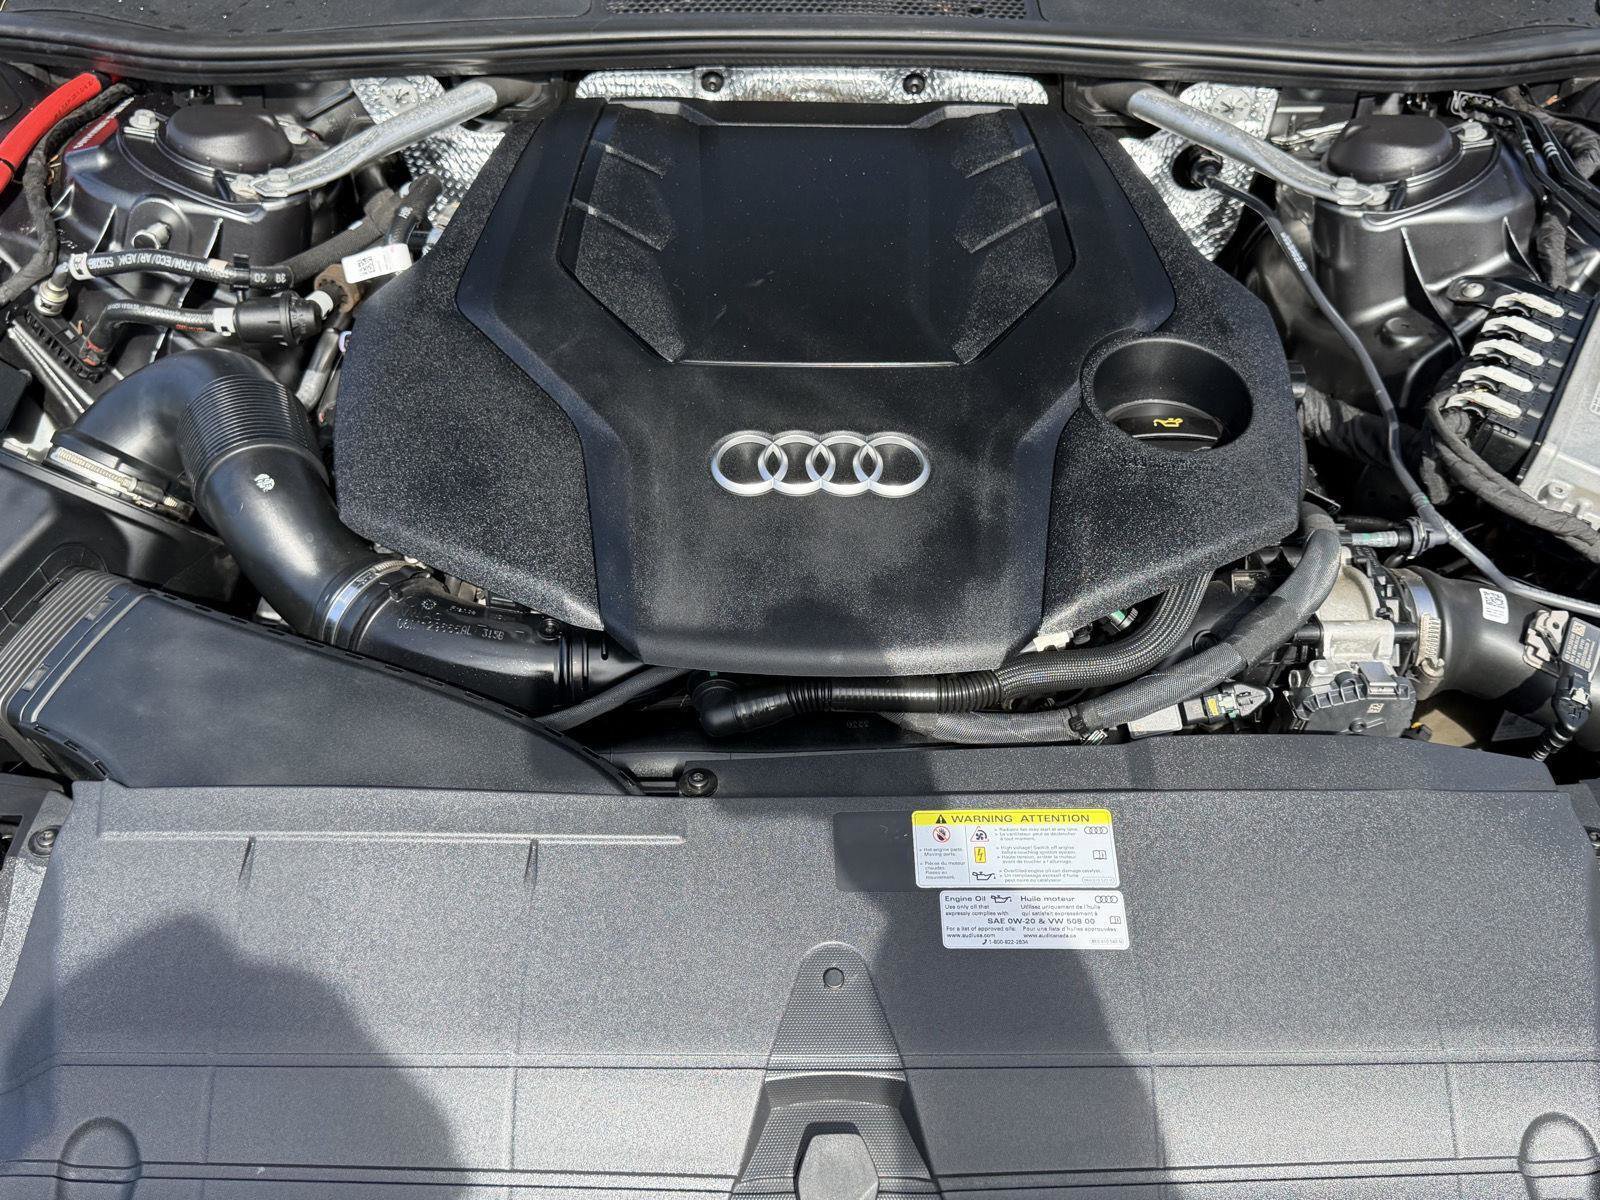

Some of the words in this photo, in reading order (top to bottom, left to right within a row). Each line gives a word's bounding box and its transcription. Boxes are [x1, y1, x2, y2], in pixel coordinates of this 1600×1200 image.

[254, 272, 267, 284] 20
[951, 815, 1013, 823] WARNING
[1020, 815, 1090, 823] ATTENTION
